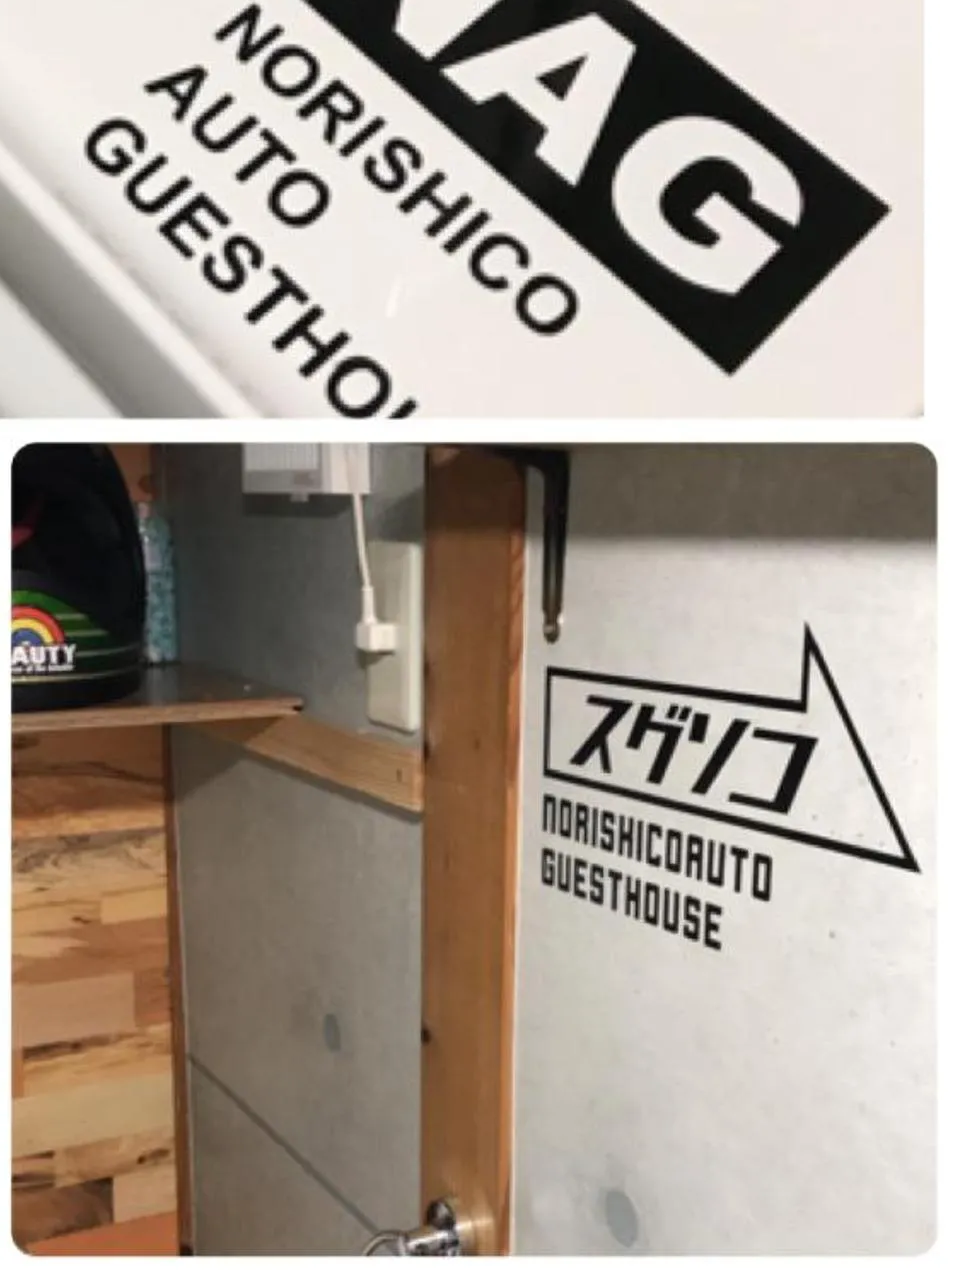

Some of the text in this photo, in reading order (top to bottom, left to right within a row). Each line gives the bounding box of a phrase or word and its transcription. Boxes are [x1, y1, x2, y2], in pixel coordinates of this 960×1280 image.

[144, 65, 331, 230] AUTO
[214, 3, 579, 337] NORISHICO
[85, 119, 419, 419] GUESTHO
[569, 694, 819, 816] スグソコ
[541, 847, 723, 951] GUESTHOUSE
[542, 793, 774, 902] NORISHICOAUTO
